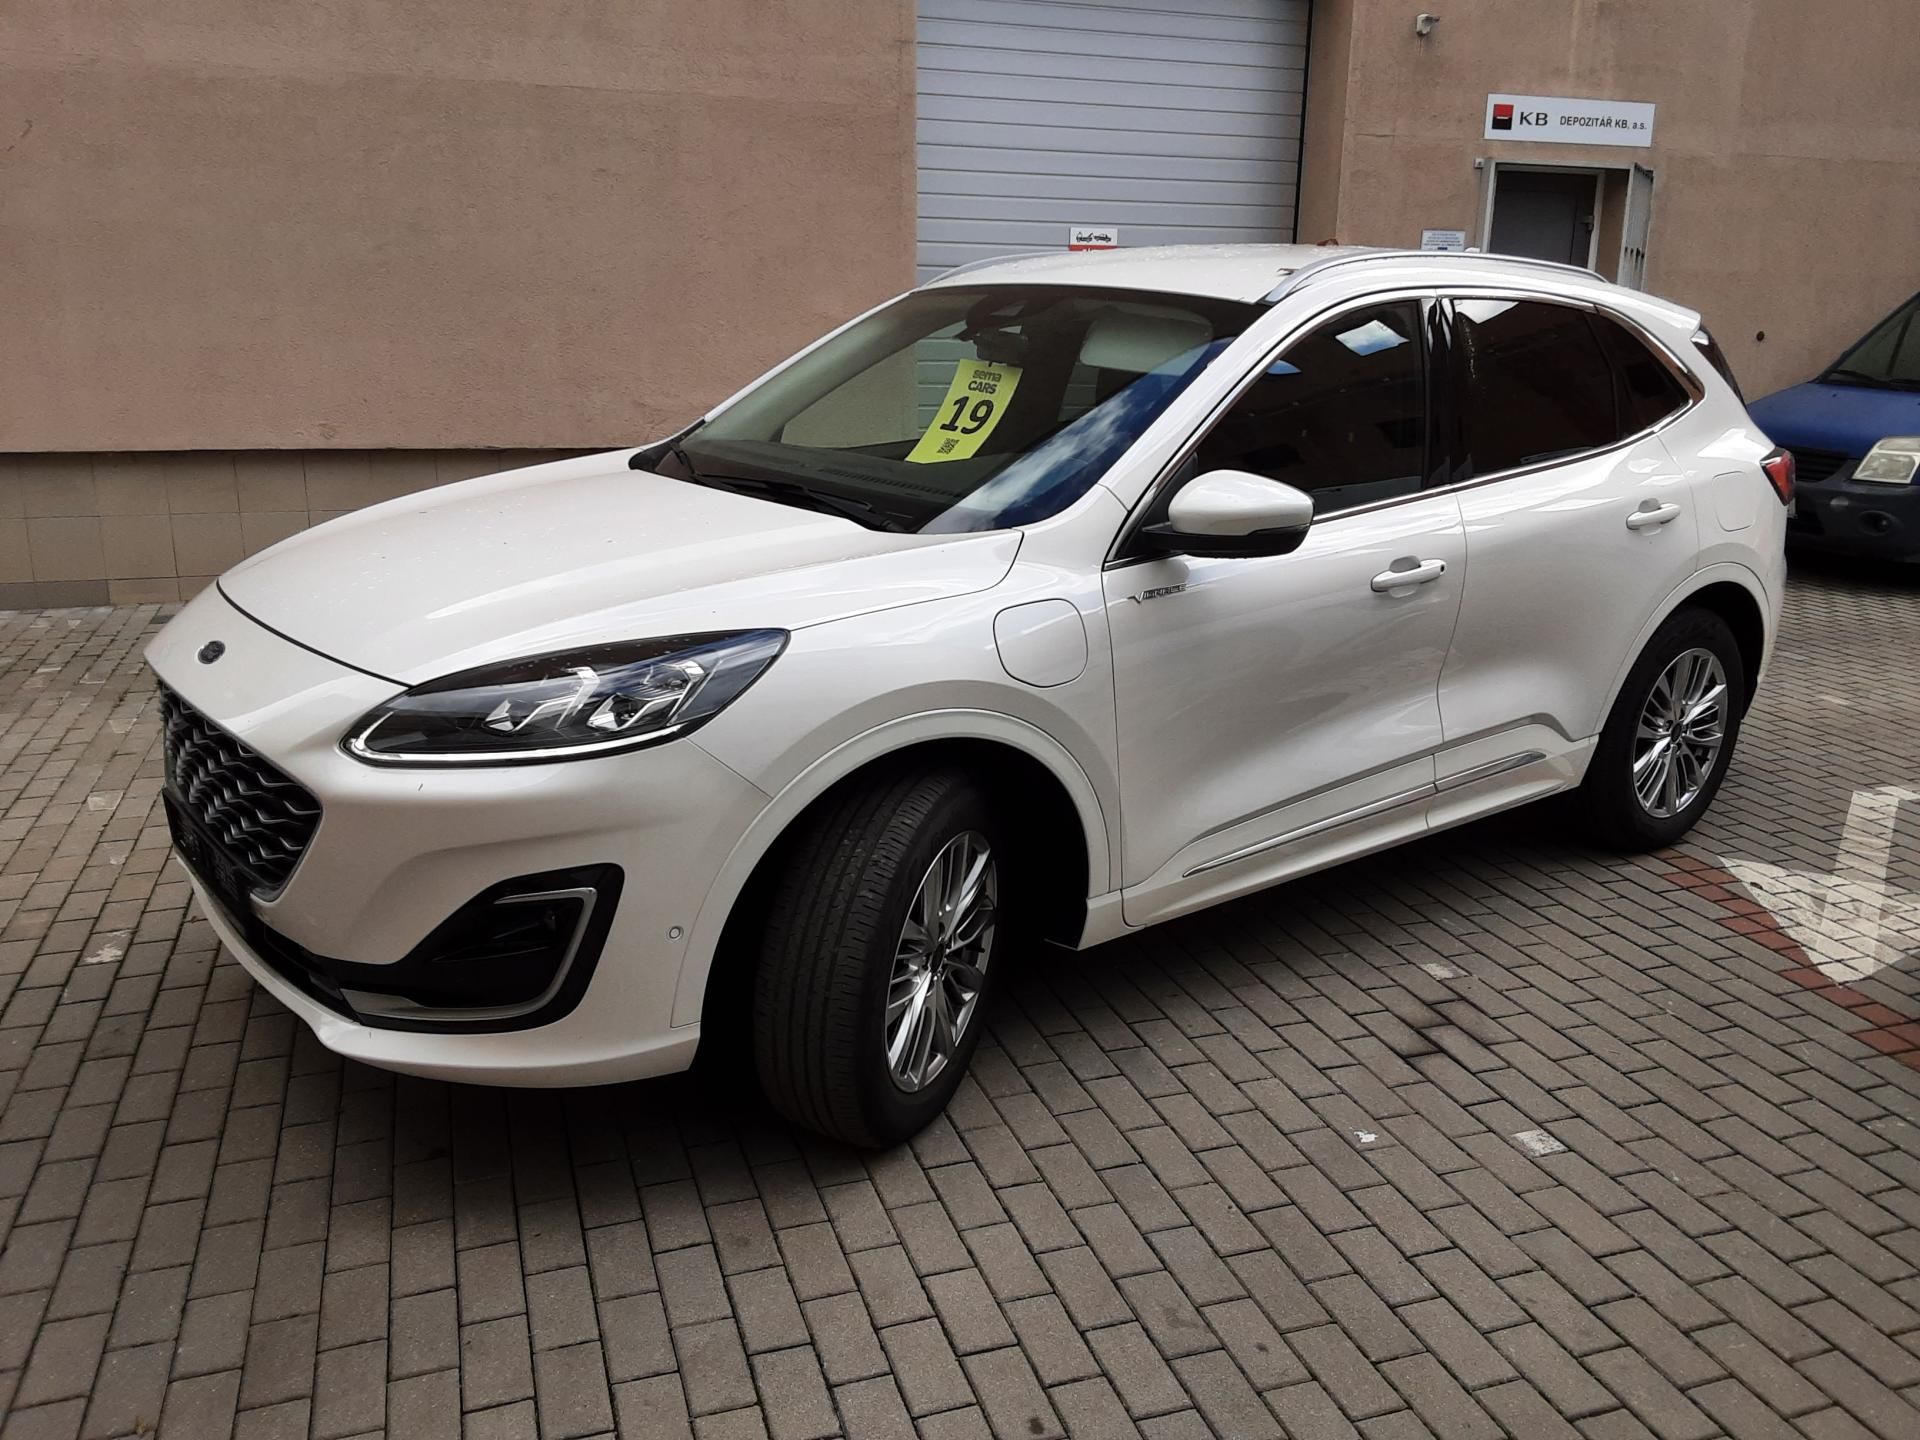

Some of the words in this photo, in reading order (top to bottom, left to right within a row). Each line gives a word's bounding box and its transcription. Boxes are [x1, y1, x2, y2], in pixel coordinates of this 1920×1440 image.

[1519, 111, 1549, 126] KB
[1559, 115, 1613, 128] DEPOZITÁŘ
[1632, 122, 1648, 130] a.s.
[972, 369, 1002, 383] sema
[967, 380, 998, 395] CARS
[939, 395, 995, 435] 19
